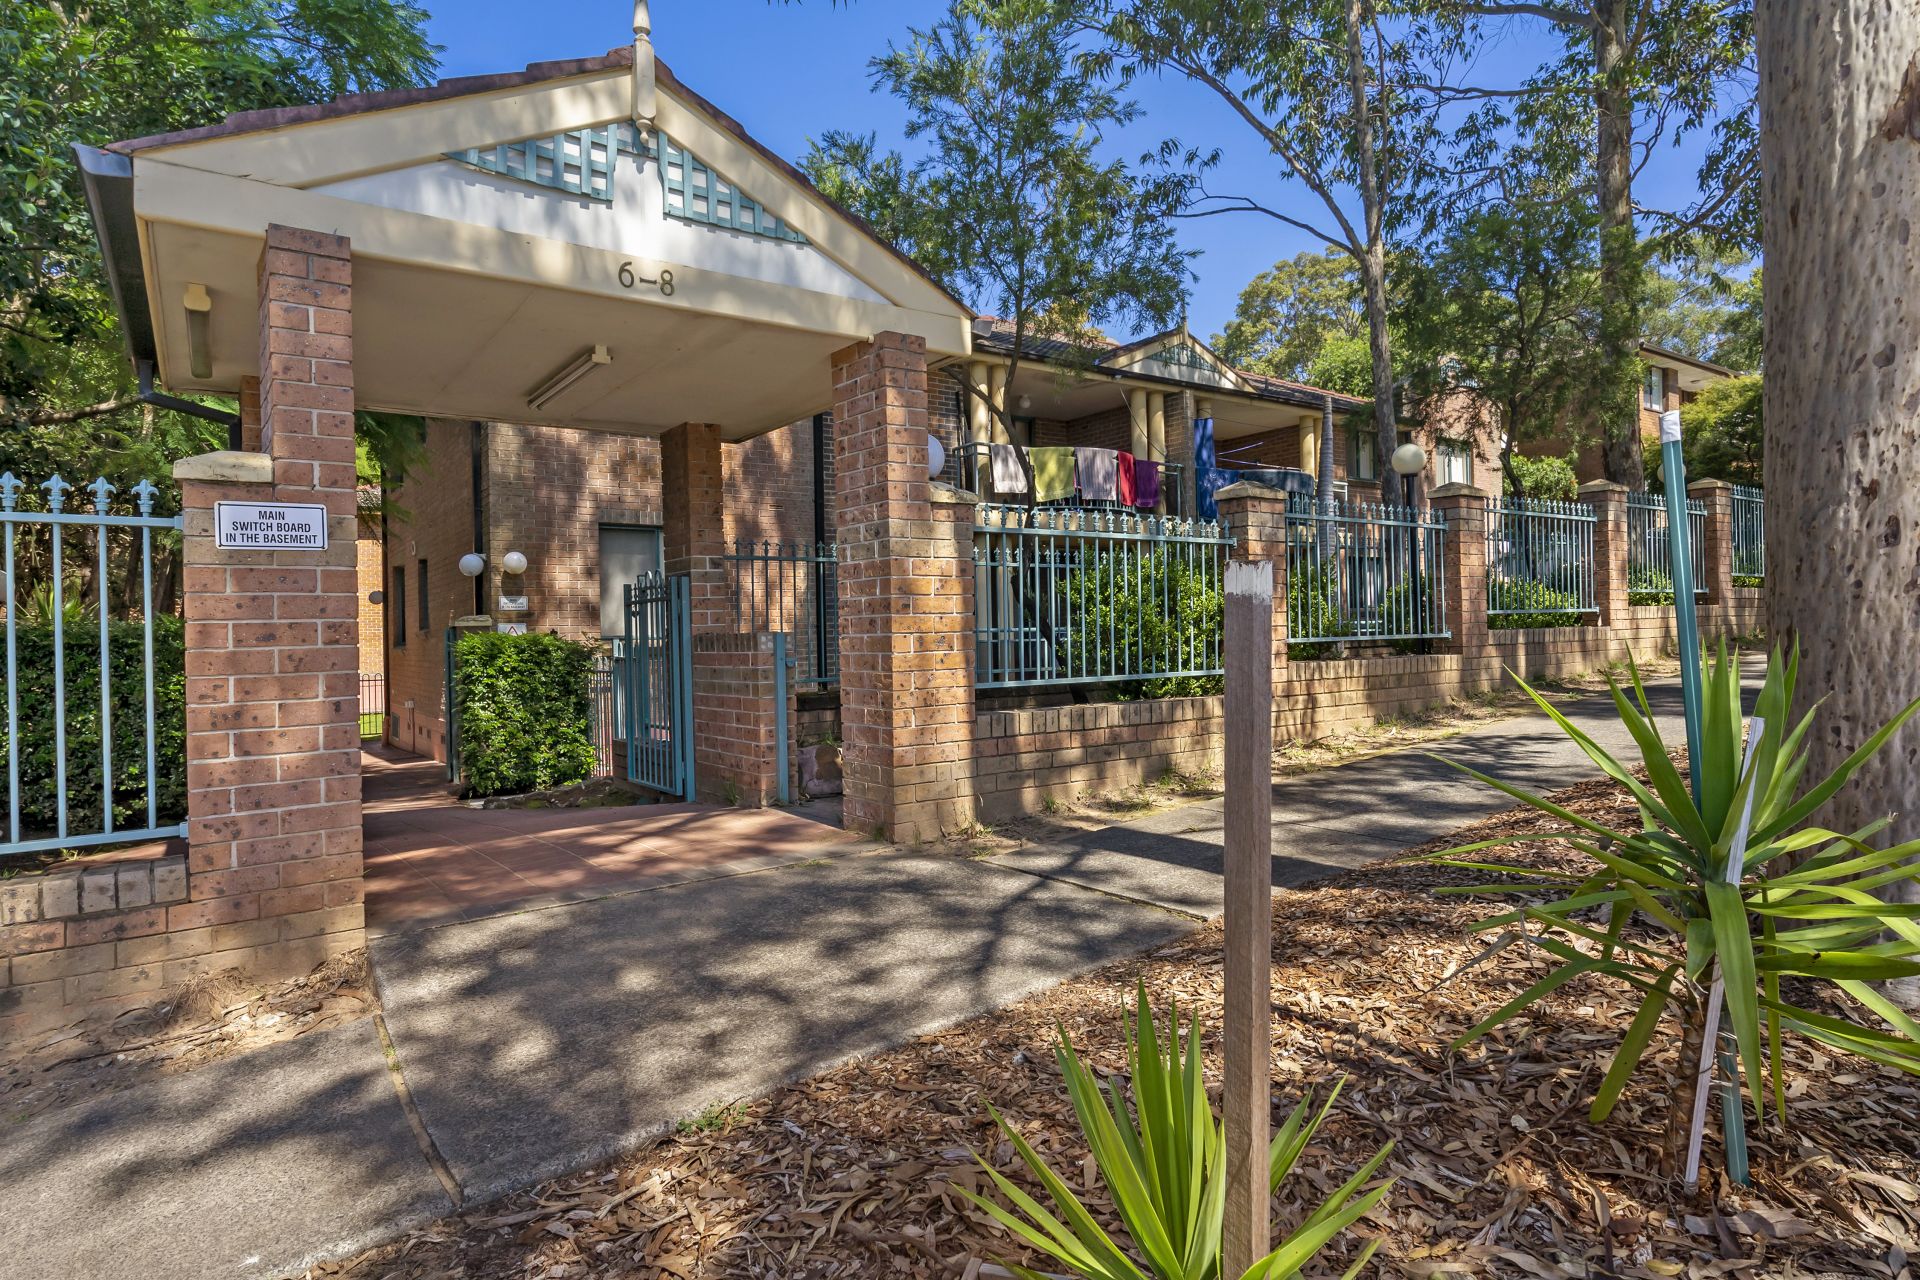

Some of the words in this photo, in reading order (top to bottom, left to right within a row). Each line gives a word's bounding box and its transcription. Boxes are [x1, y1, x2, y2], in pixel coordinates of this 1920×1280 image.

[618, 261, 675, 296] 6-8
[258, 510, 285, 520] MAIN
[232, 521, 273, 532] SWITCH
[276, 522, 311, 533] BOARD
[225, 533, 236, 543] IN
[240, 533, 260, 543] THE
[263, 534, 318, 544] BASEMENT
